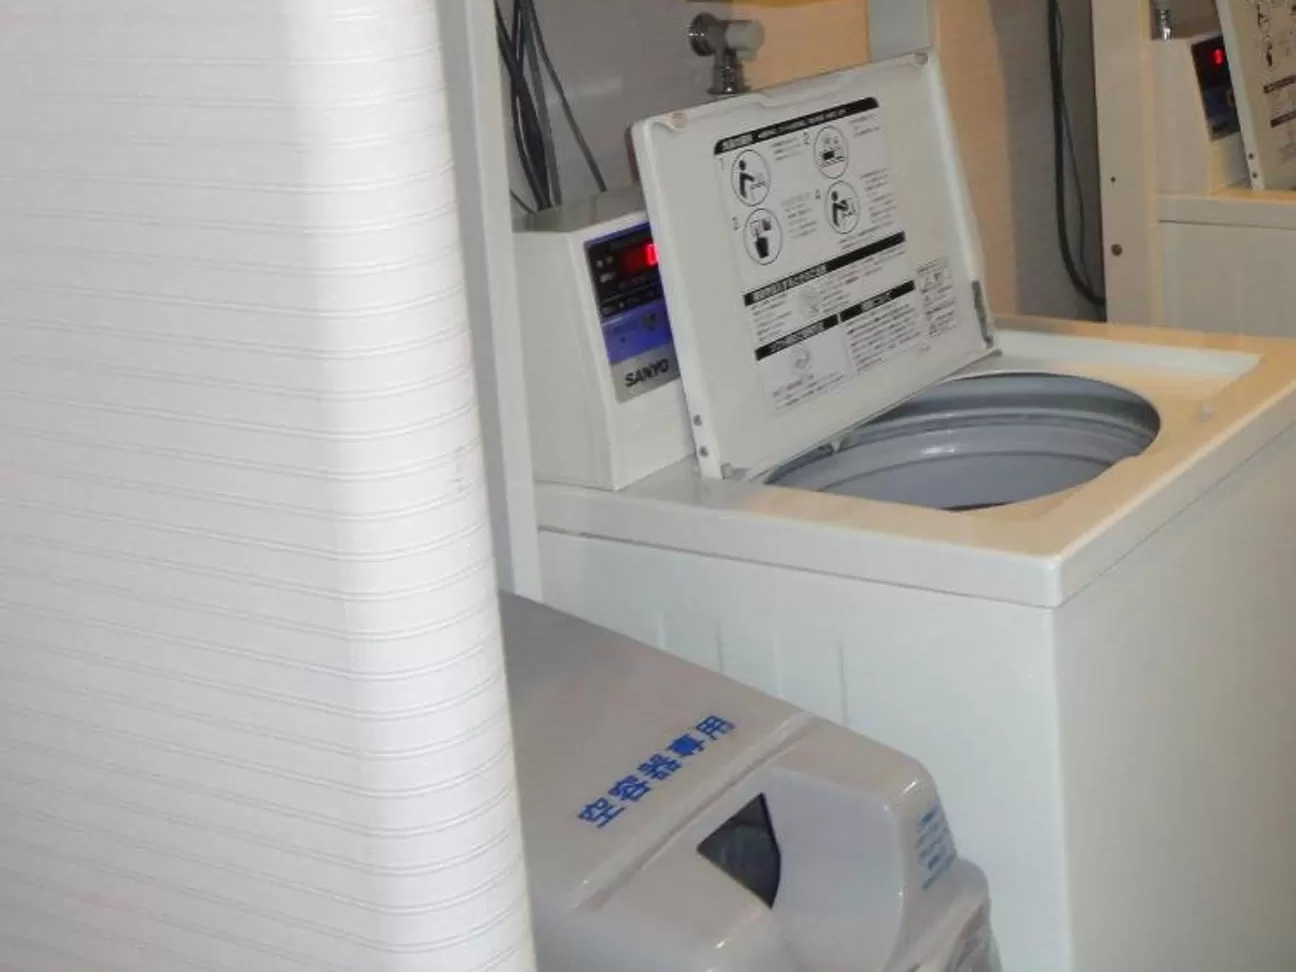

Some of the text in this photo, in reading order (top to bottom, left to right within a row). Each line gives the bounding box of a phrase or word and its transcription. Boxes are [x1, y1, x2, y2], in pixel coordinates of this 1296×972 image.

[624, 358, 669, 388] SANYO
[577, 715, 735, 828] 空容器専用
